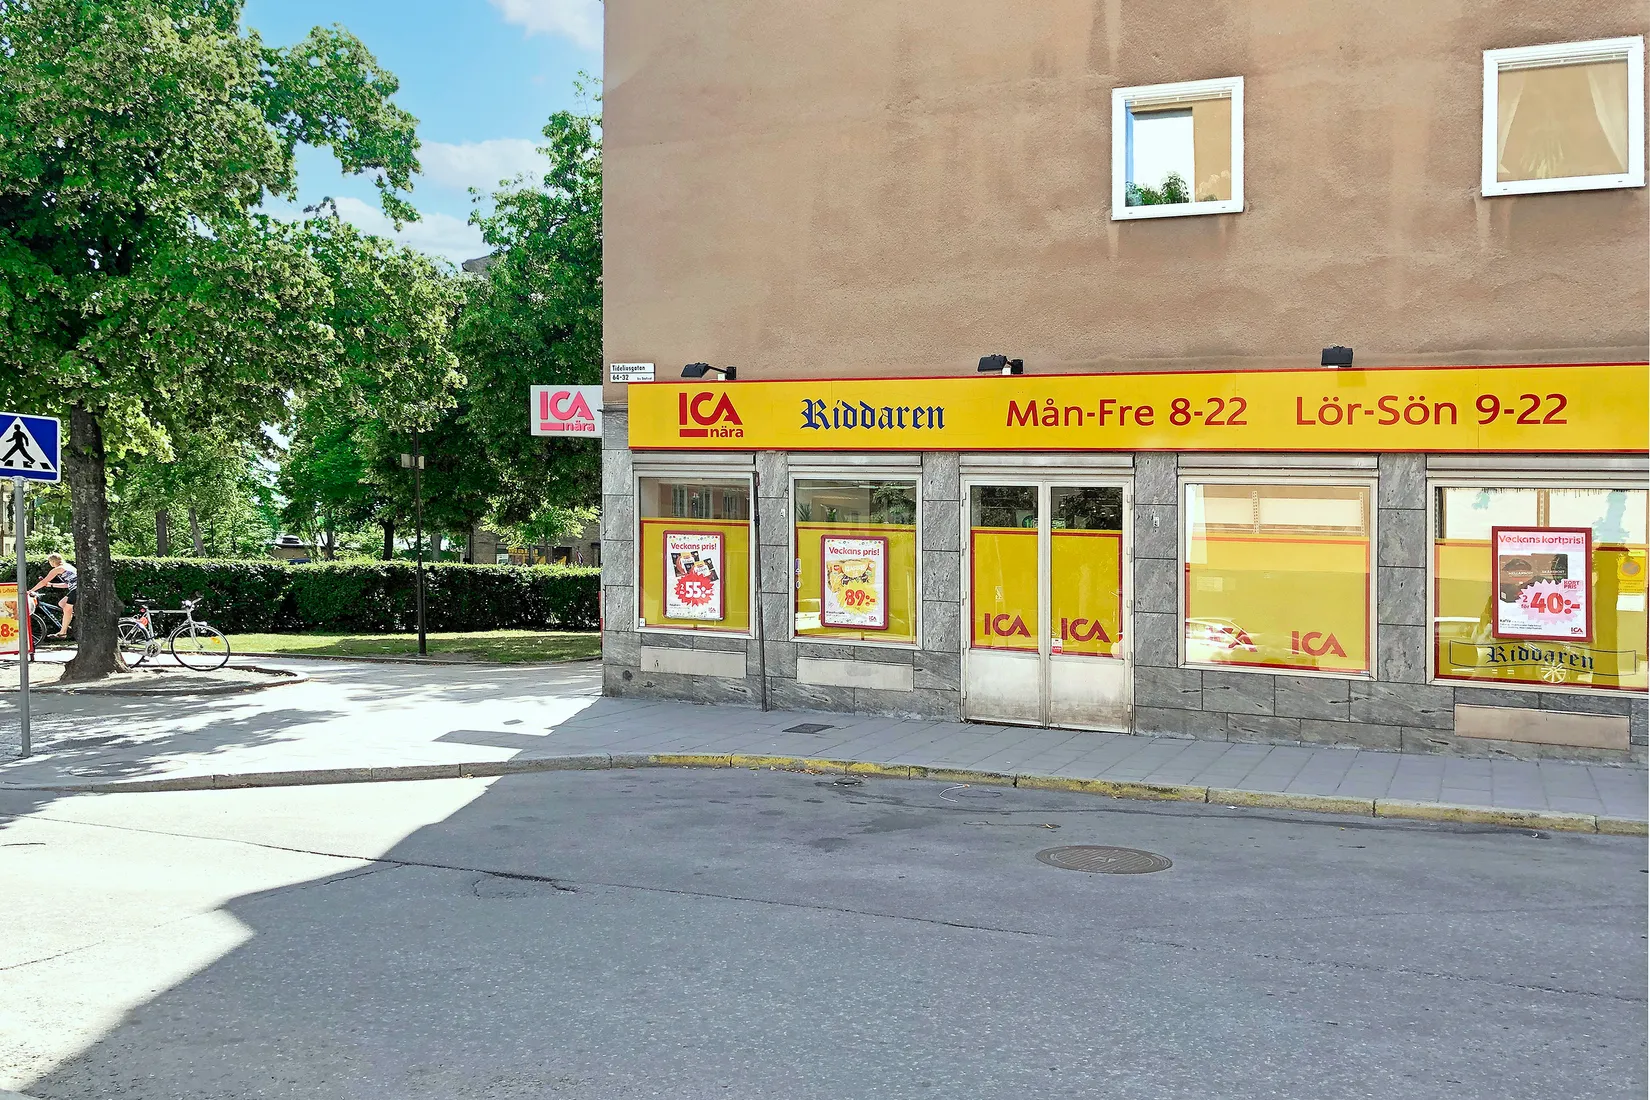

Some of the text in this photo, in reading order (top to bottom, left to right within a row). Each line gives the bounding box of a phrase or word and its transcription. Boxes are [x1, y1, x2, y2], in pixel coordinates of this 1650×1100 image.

[540, 390, 595, 421] ICA
[679, 391, 744, 426] ICA
[800, 398, 945, 430] Riddaren
[1006, 397, 1248, 427] Mån-Fre 8-22
[1296, 393, 1568, 426] Lör-Sön 9-22
[565, 420, 596, 432] nära
[709, 426, 744, 438] nära
[671, 542, 717, 551] Veckans pris!
[829, 546, 880, 556] Veckans pris!
[1499, 535, 1584, 545] Veckans kortpris!
[685, 581, 711, 599] 55:-
[845, 589, 876, 606] 89:-
[1522, 595, 1528, 603] 2
[1530, 592, 1580, 615] 40:-
[0, 623, 19, 638] 8:-
[984, 613, 1031, 637] ICA
[1061, 617, 1111, 643] ICA
[1291, 630, 1348, 658] ICA
[1486, 645, 1595, 670] Riddaren
